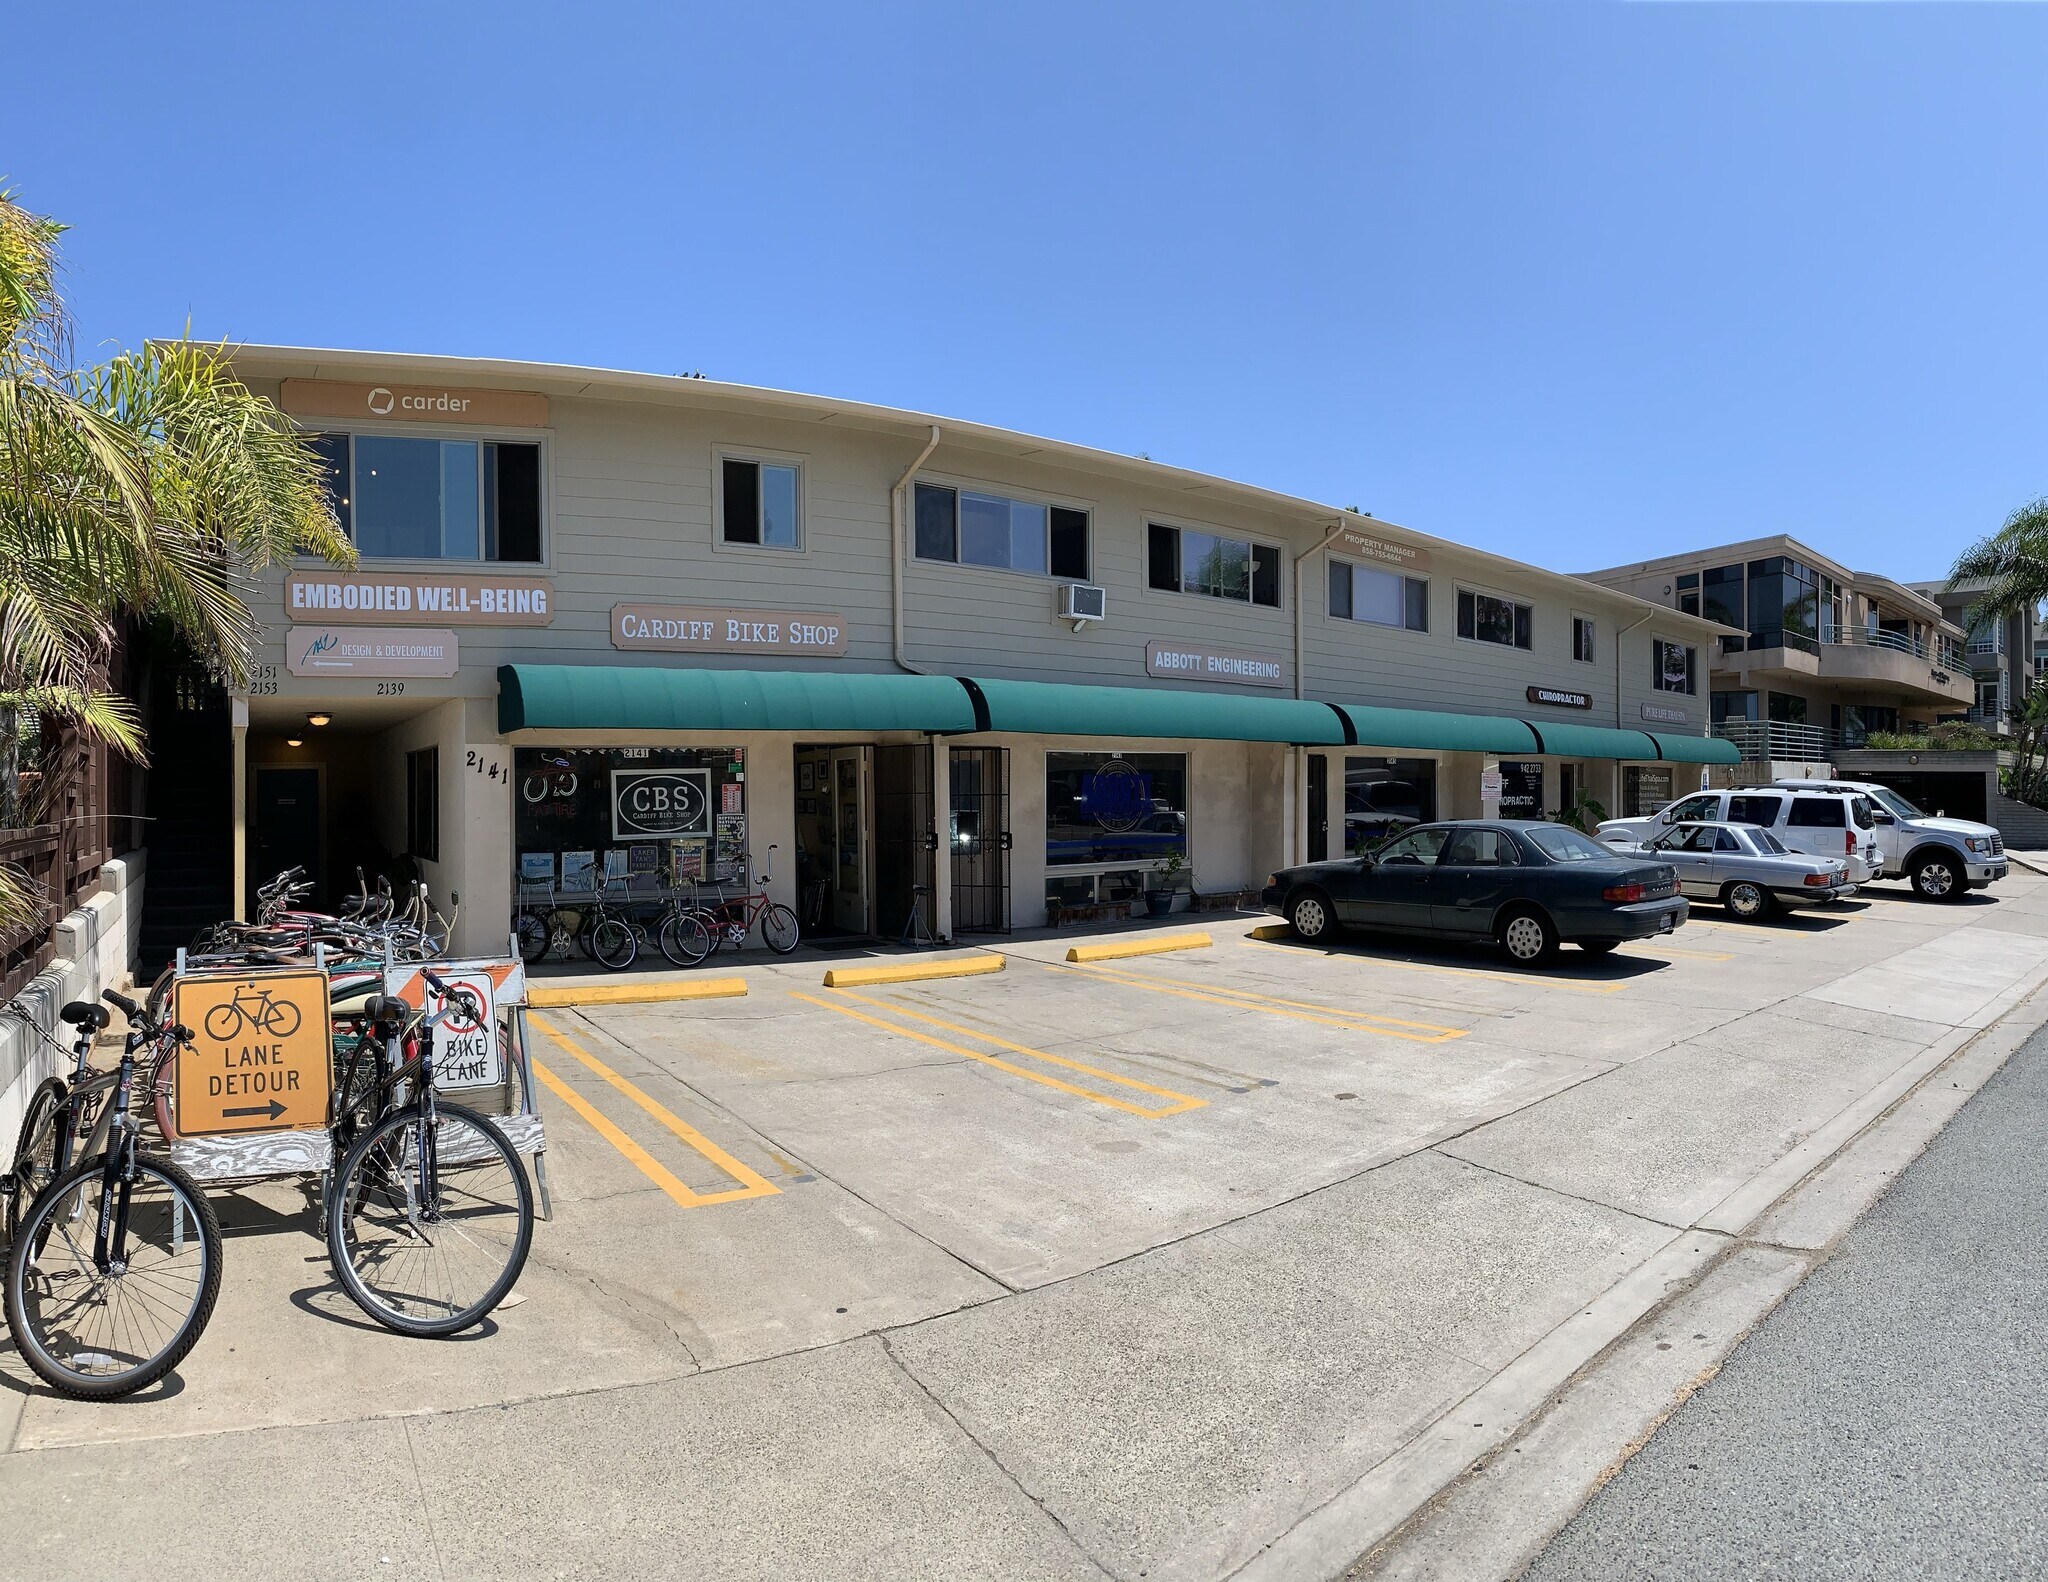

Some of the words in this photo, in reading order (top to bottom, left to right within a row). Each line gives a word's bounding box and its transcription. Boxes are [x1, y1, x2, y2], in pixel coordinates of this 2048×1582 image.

[401, 393, 471, 412] carder
[1344, 533, 1382, 549] PROPERTY
[1384, 543, 1416, 558] MANAGER
[1362, 546, 1402, 562] 858-755-6644
[292, 583, 411, 611] EMBODIED
[416, 586, 547, 614] WELL-BEING
[621, 614, 713, 640] CARDIFF
[726, 619, 780, 643] BIKE
[789, 622, 839, 645] SHOP
[341, 644, 372, 656] DESIGN
[376, 645, 383, 657] &
[385, 645, 444, 657] DEVELOPMENT
[1155, 651, 1202, 671] ABBOTT
[1207, 656, 1280, 679] ENGINEERING
[250, 682, 278, 695] 2153
[377, 683, 405, 695] 2139
[1538, 690, 1585, 706] CHIROPRACTOR
[624, 749, 649, 758] 2141
[466, 751, 507, 784] 2141
[632, 786, 690, 812] CBS
[527, 803, 550, 817] FAT
[552, 802, 577, 817] TIRE
[632, 812, 657, 820] CARDIFF
[659, 811, 674, 819] BIKE
[225, 1044, 284, 1068] LANE
[446, 1038, 486, 1058] BIKE
[446, 1061, 488, 1081] LANE
[209, 1070, 300, 1096] DETOUR
